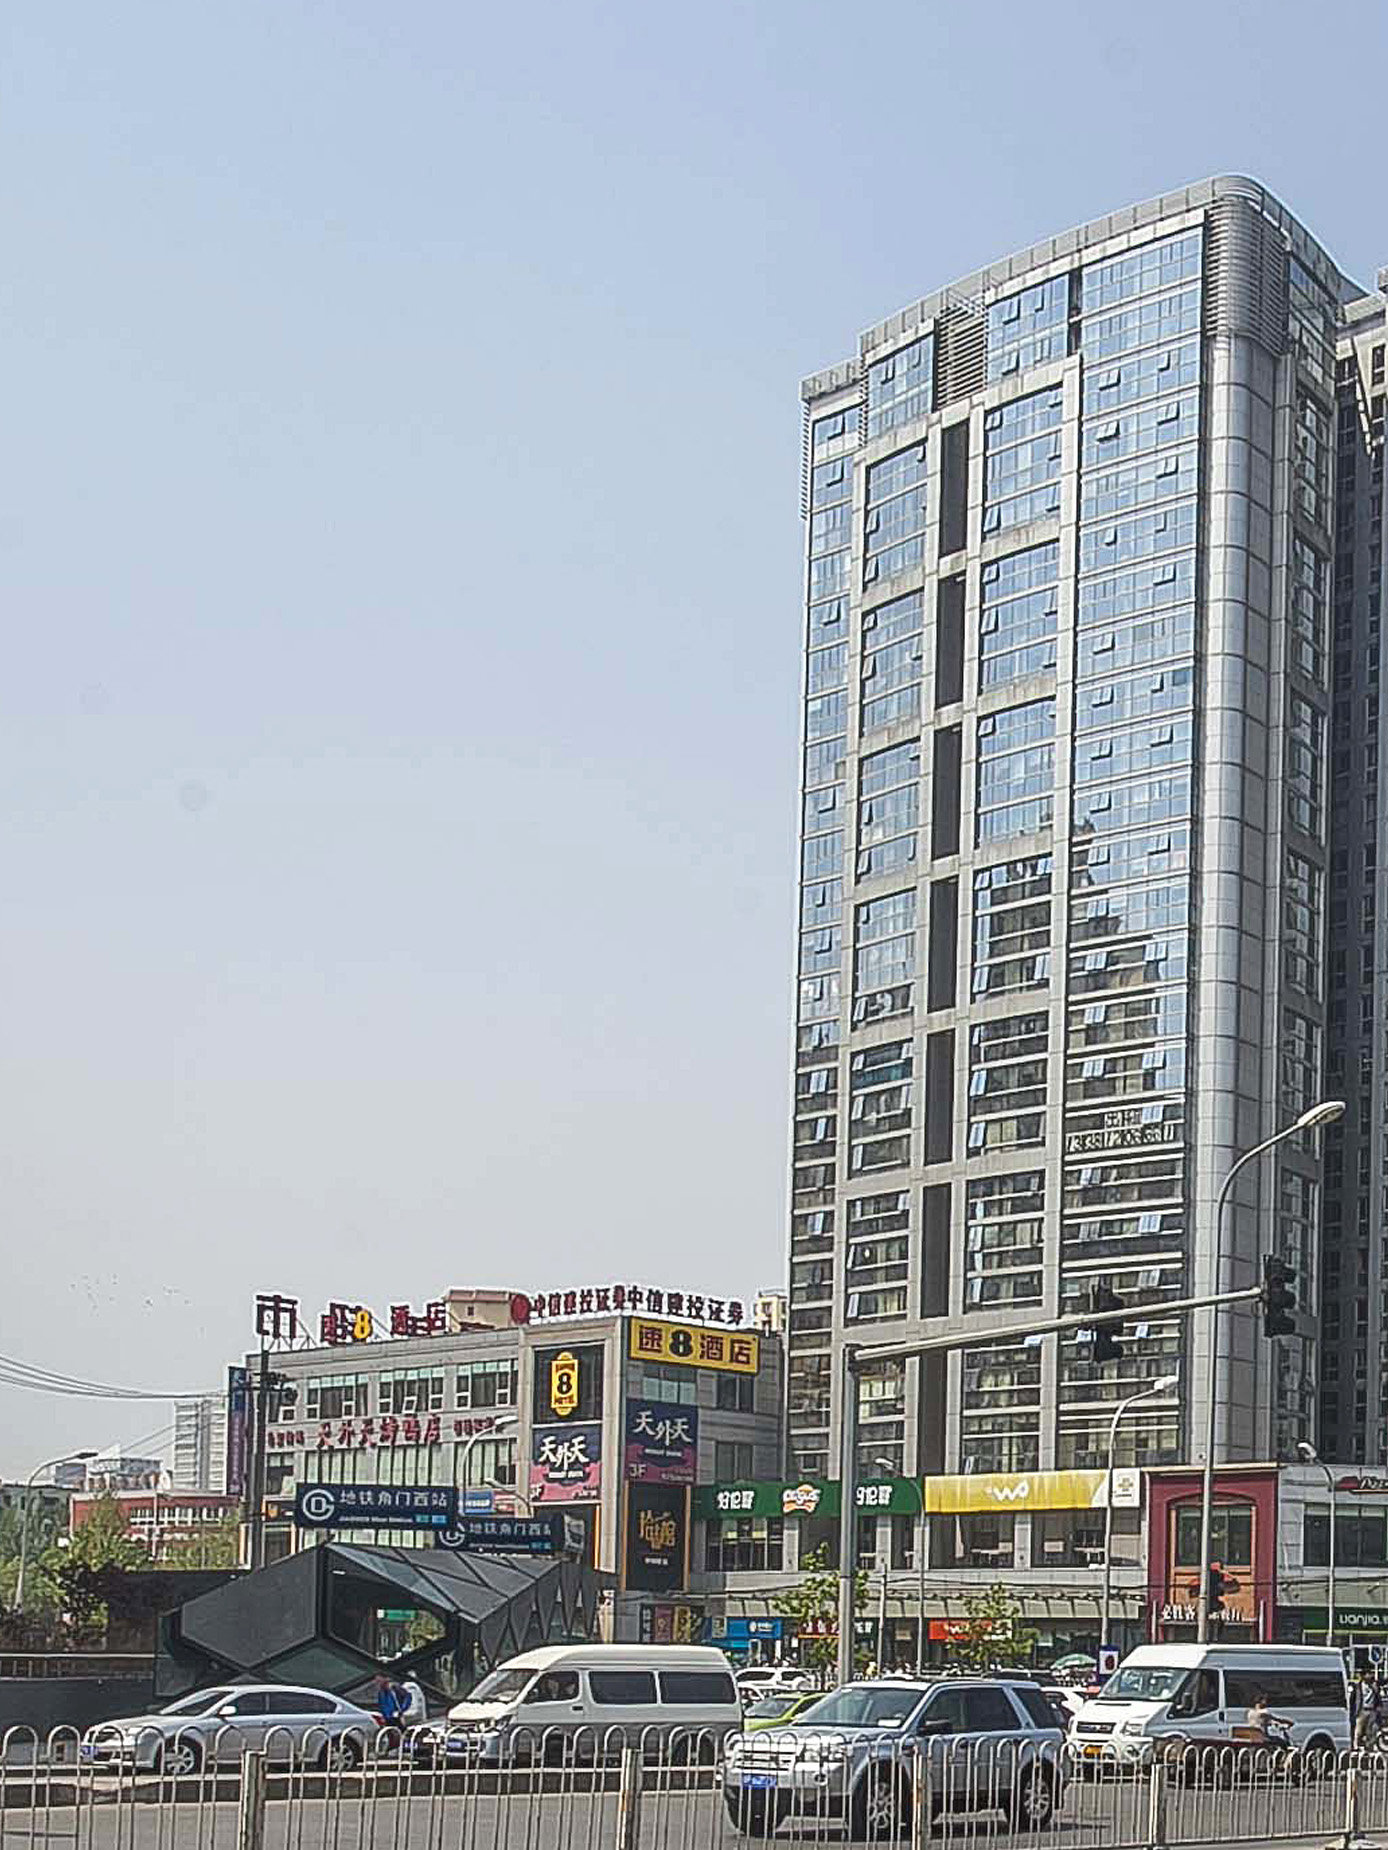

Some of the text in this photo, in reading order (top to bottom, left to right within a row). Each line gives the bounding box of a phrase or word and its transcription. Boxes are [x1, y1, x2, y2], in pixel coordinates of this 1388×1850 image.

[627, 1285, 744, 1326] 中信建投证券
[638, 1325, 755, 1366] 速8酒店
[632, 1410, 694, 1447] 天外天
[538, 1435, 590, 1471] 天外天
[340, 1489, 448, 1507] 地铁角门西站
